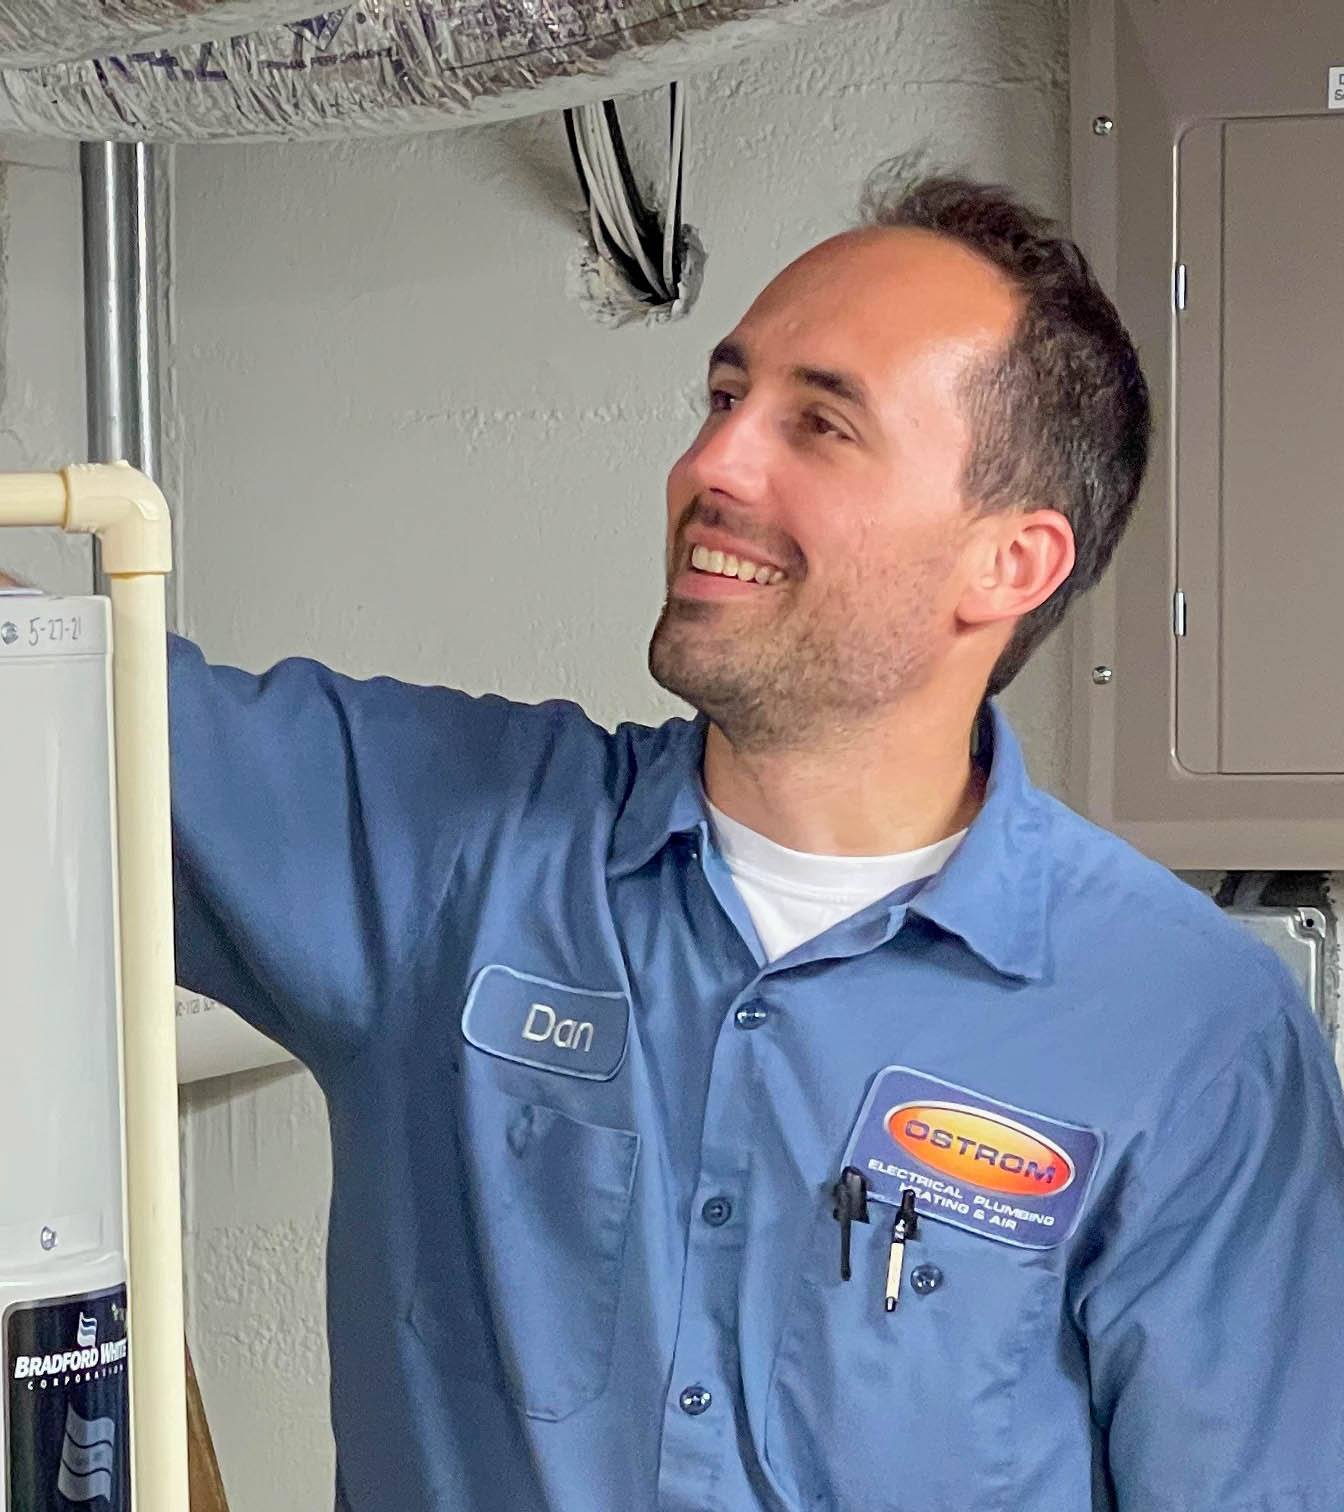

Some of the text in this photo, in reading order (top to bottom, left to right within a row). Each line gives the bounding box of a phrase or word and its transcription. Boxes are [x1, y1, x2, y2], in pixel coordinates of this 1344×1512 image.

[28, 616, 82, 647] 5-27-21
[521, 1003, 594, 1052] Dan
[905, 1119, 1056, 1185] OSTROM
[868, 1158, 1056, 1227] ELECTRICAL PLUMBING
[989, 1216, 1018, 1232] AIR
[14, 1347, 99, 1379] BRADFORD
